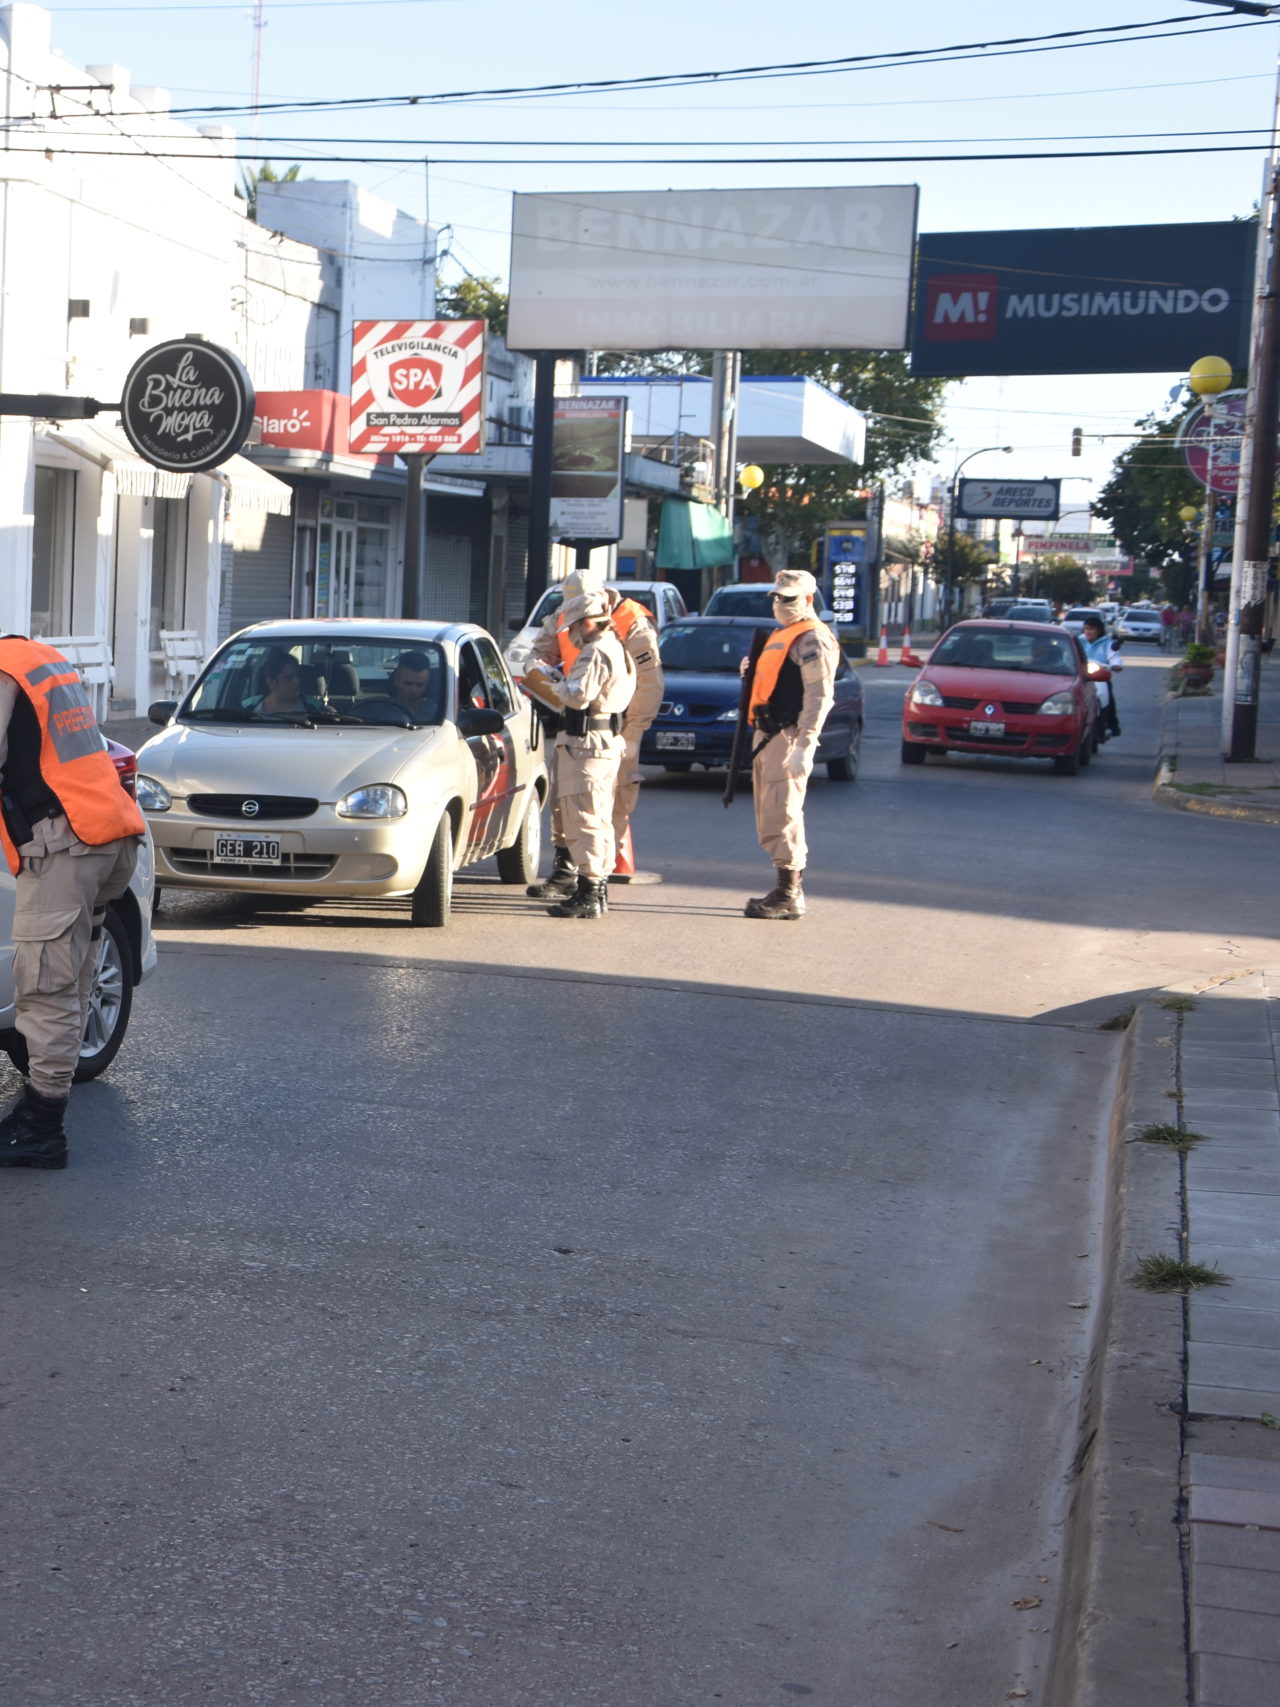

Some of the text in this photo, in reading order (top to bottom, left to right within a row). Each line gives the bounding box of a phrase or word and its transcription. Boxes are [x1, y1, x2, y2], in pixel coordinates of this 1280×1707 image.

[536, 203, 883, 252] BENNAZAR
[591, 273, 818, 290] www.bennazar.com.ar
[933, 291, 990, 323] M!
[1005, 287, 1229, 318] MUSIMUNDO
[373, 341, 459, 359] TELEVIGILANCIA
[165, 351, 202, 389] La
[393, 368, 437, 390] SPA
[139, 373, 225, 412] Buena
[558, 400, 615, 410] BENNAZAR
[369, 413, 460, 425] San Pedro Alarmas
[996, 486, 1036, 498] ARECO
[992, 498, 1052, 509] DEPORTES
[1028, 540, 1090, 551] PIMPINELA
[252, 842, 278, 858] 210
